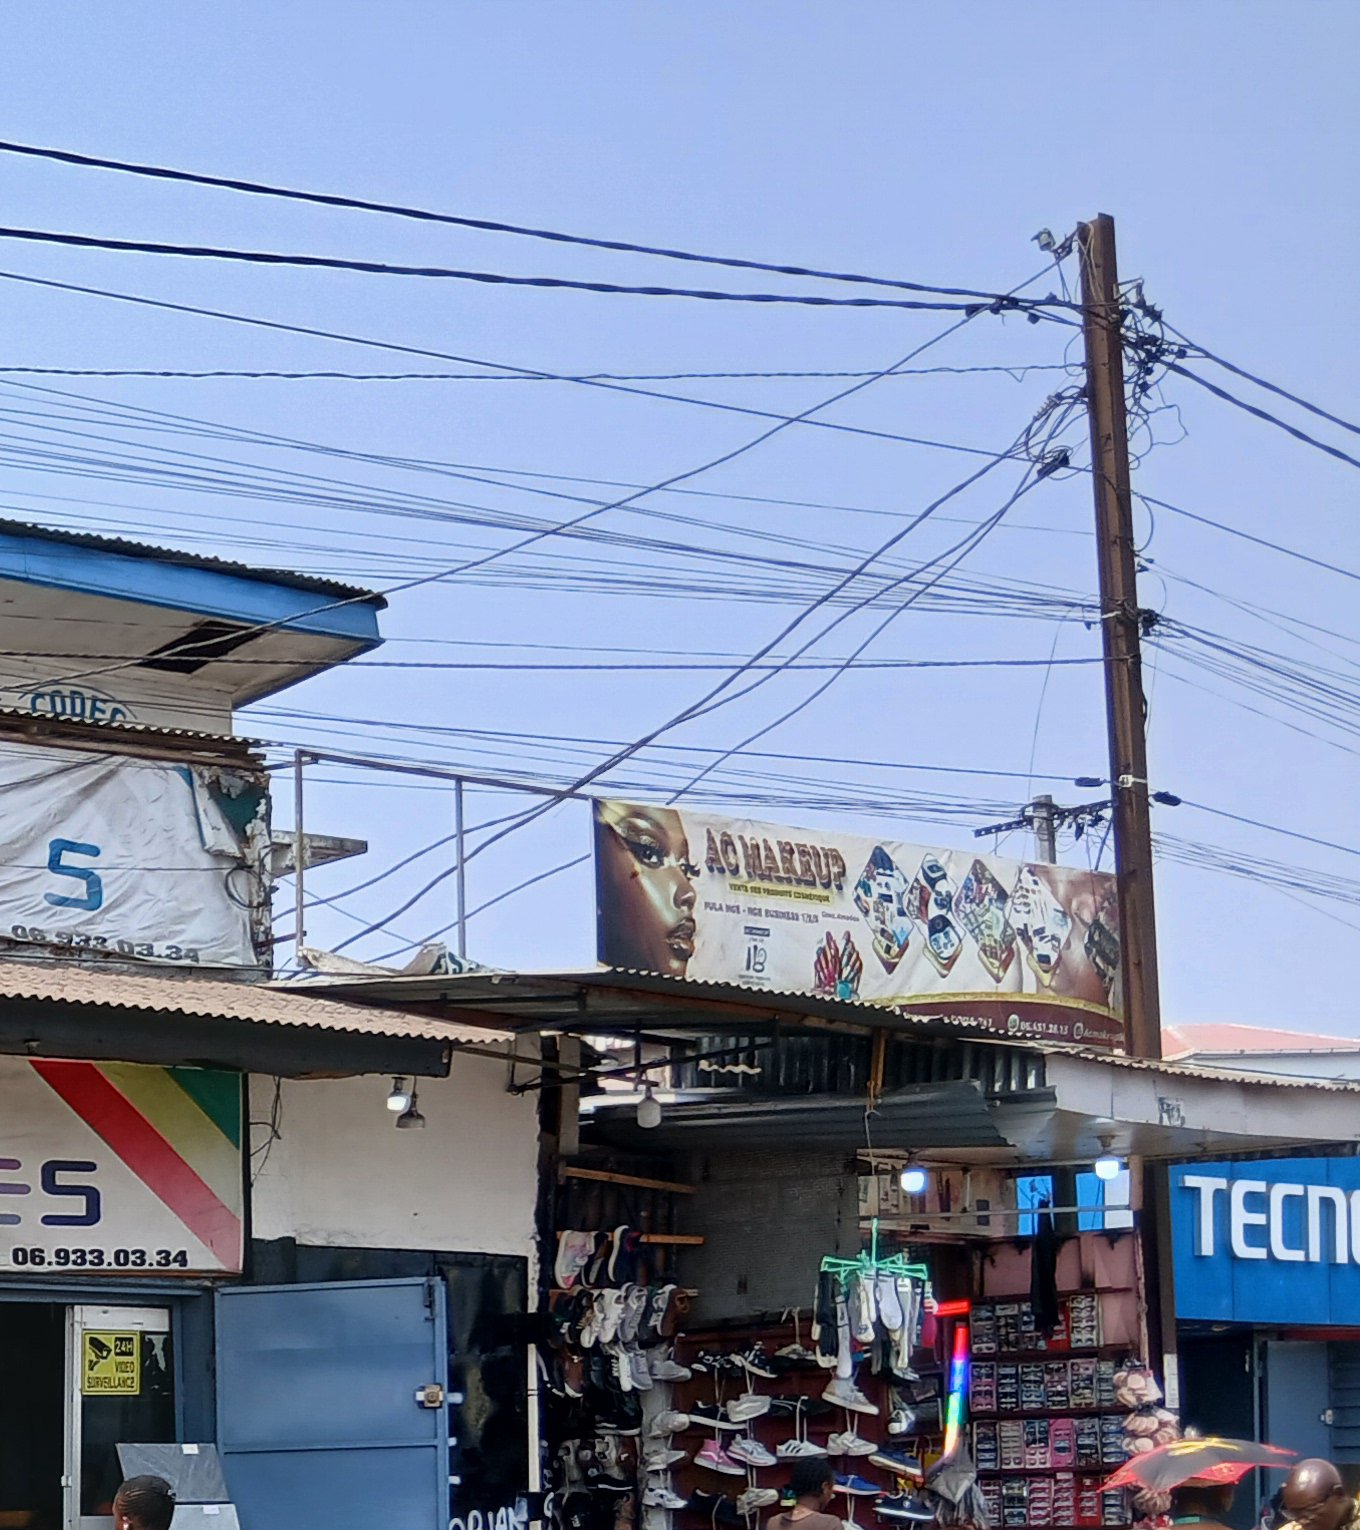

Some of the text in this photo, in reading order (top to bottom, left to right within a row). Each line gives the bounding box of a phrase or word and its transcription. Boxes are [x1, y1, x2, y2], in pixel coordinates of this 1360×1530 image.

[705, 828, 847, 891] AC MAKEUP
[1184, 1175, 1360, 1265] TECN
[12, 1246, 189, 1269] 06.933.03.34
[115, 1340, 133, 1353] 24H
[114, 1361, 135, 1373] VIDEO
